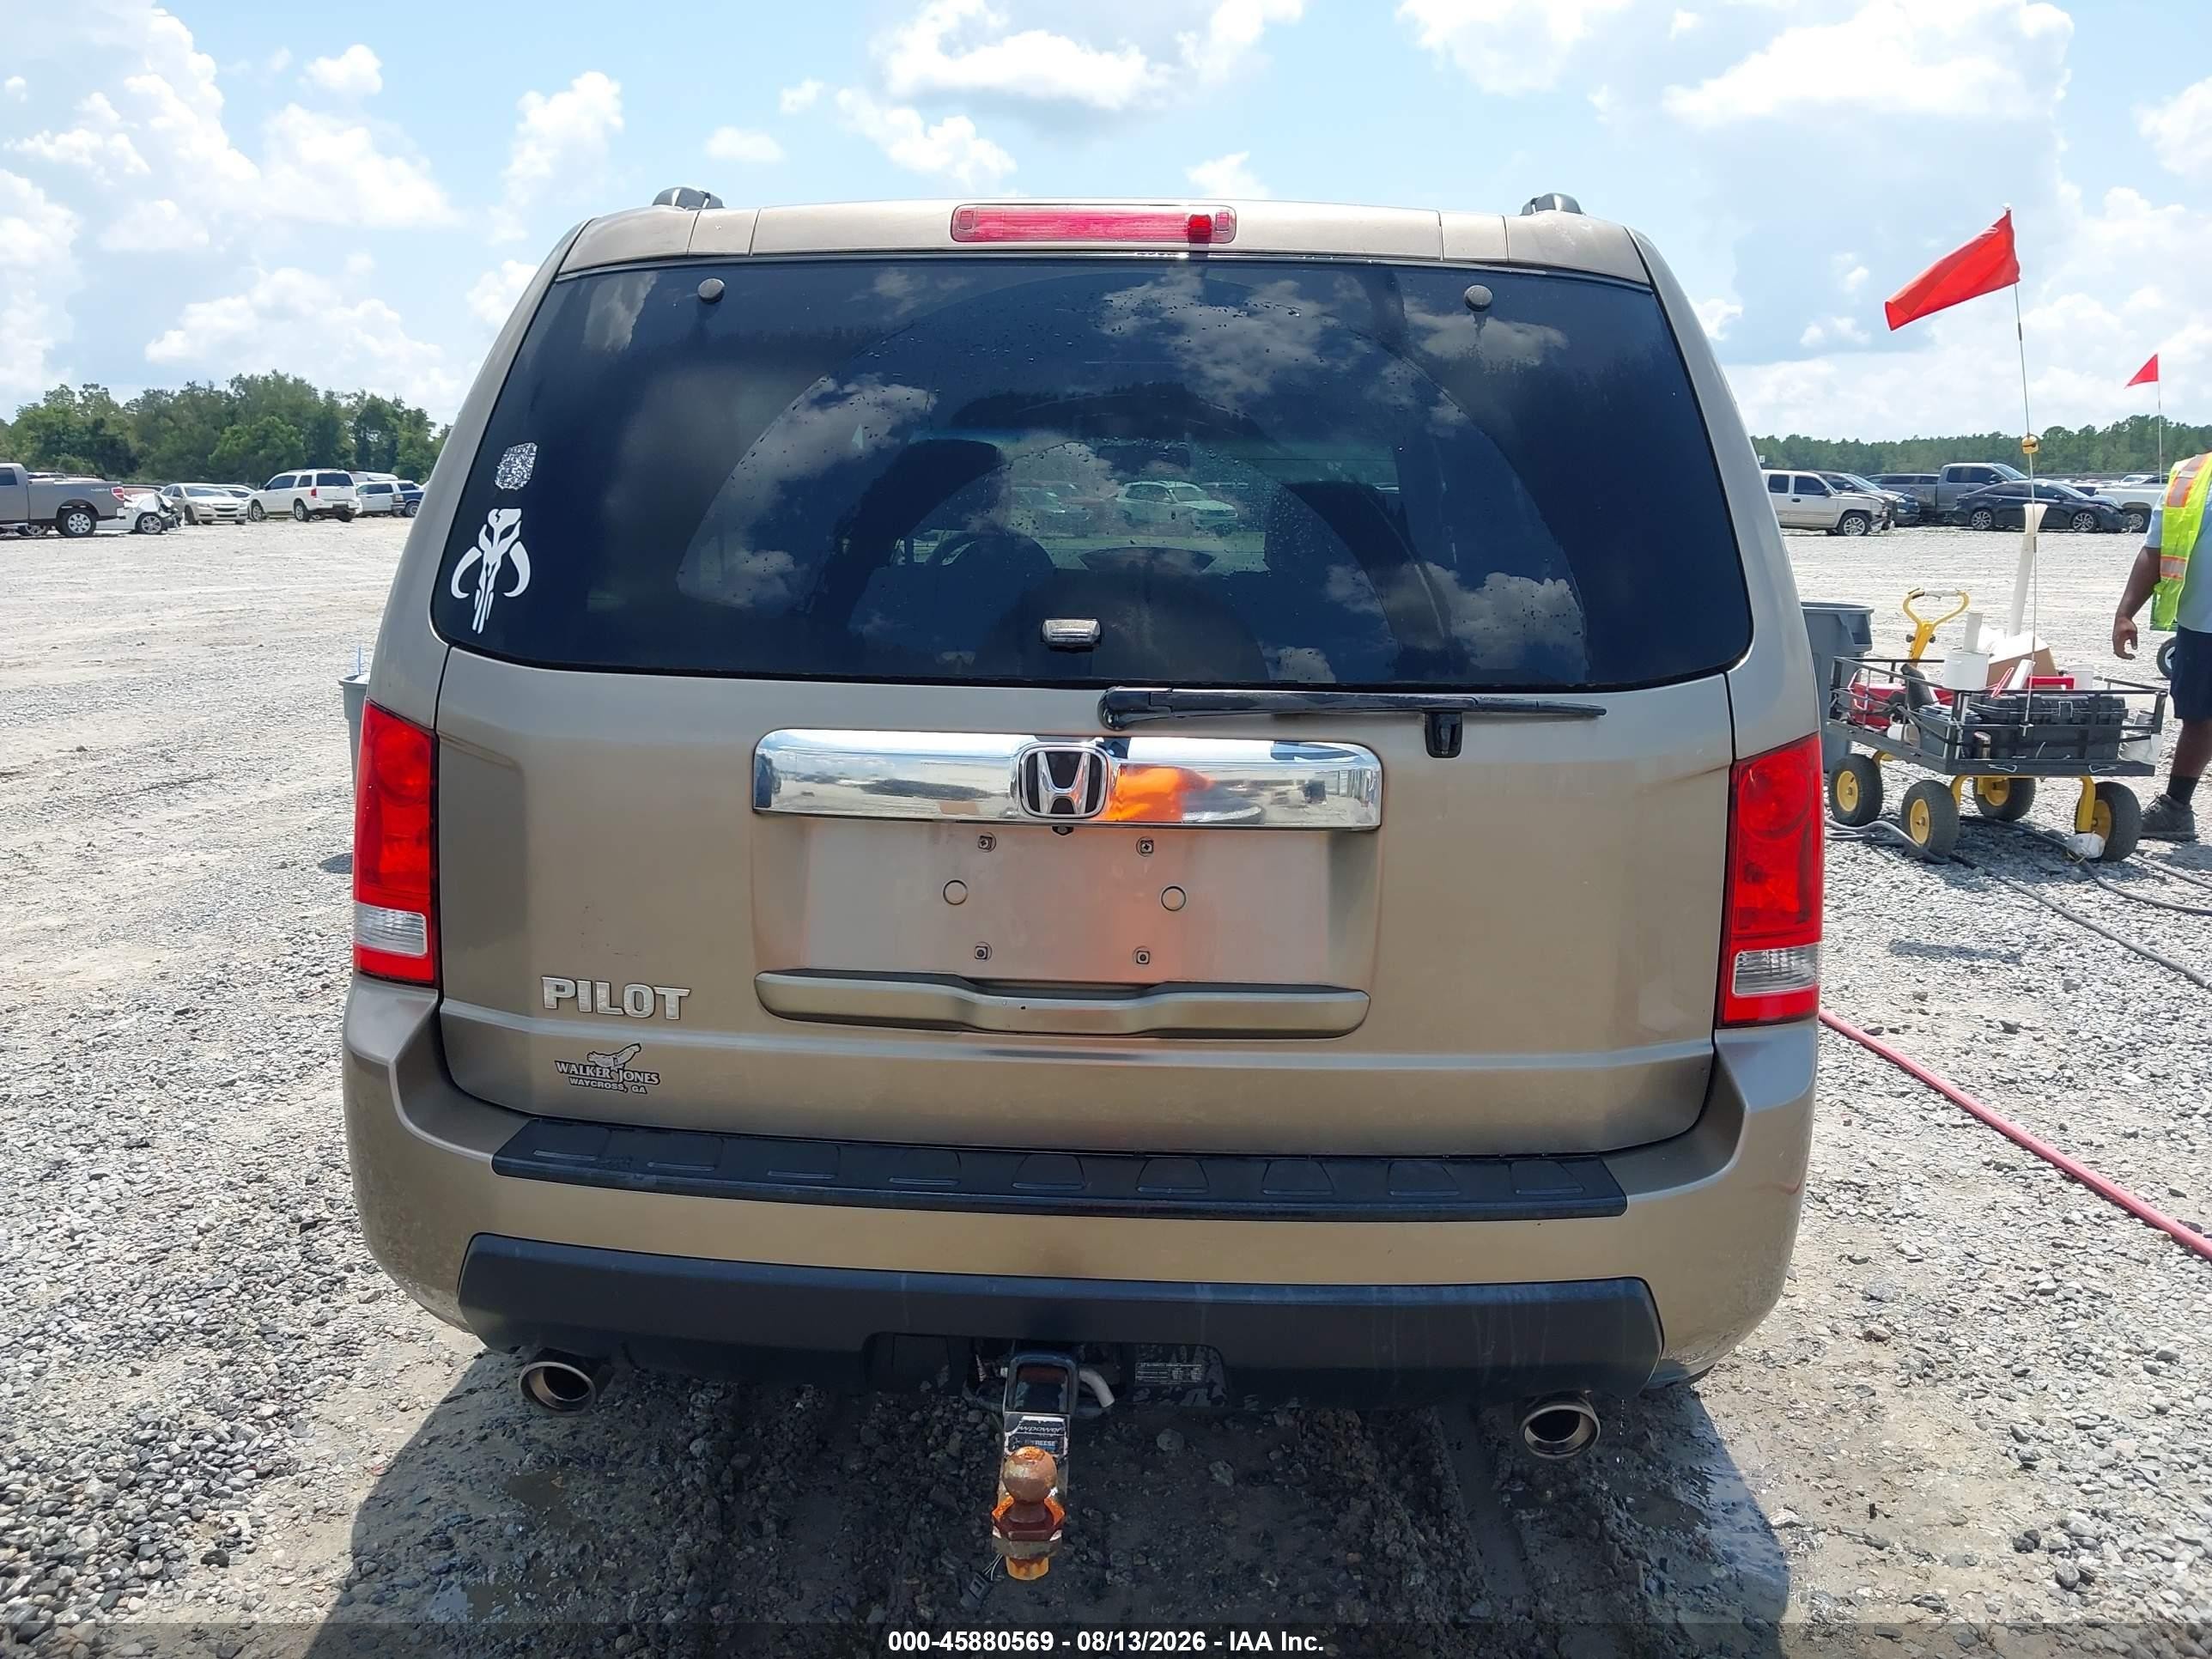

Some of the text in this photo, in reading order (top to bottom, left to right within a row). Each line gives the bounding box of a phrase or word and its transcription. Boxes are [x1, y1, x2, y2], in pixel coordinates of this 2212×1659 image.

[541, 975, 690, 1020] PILOT
[555, 1060, 659, 1085] WALKER JONES
[568, 1077, 647, 1094] WAYCROSS, GA
